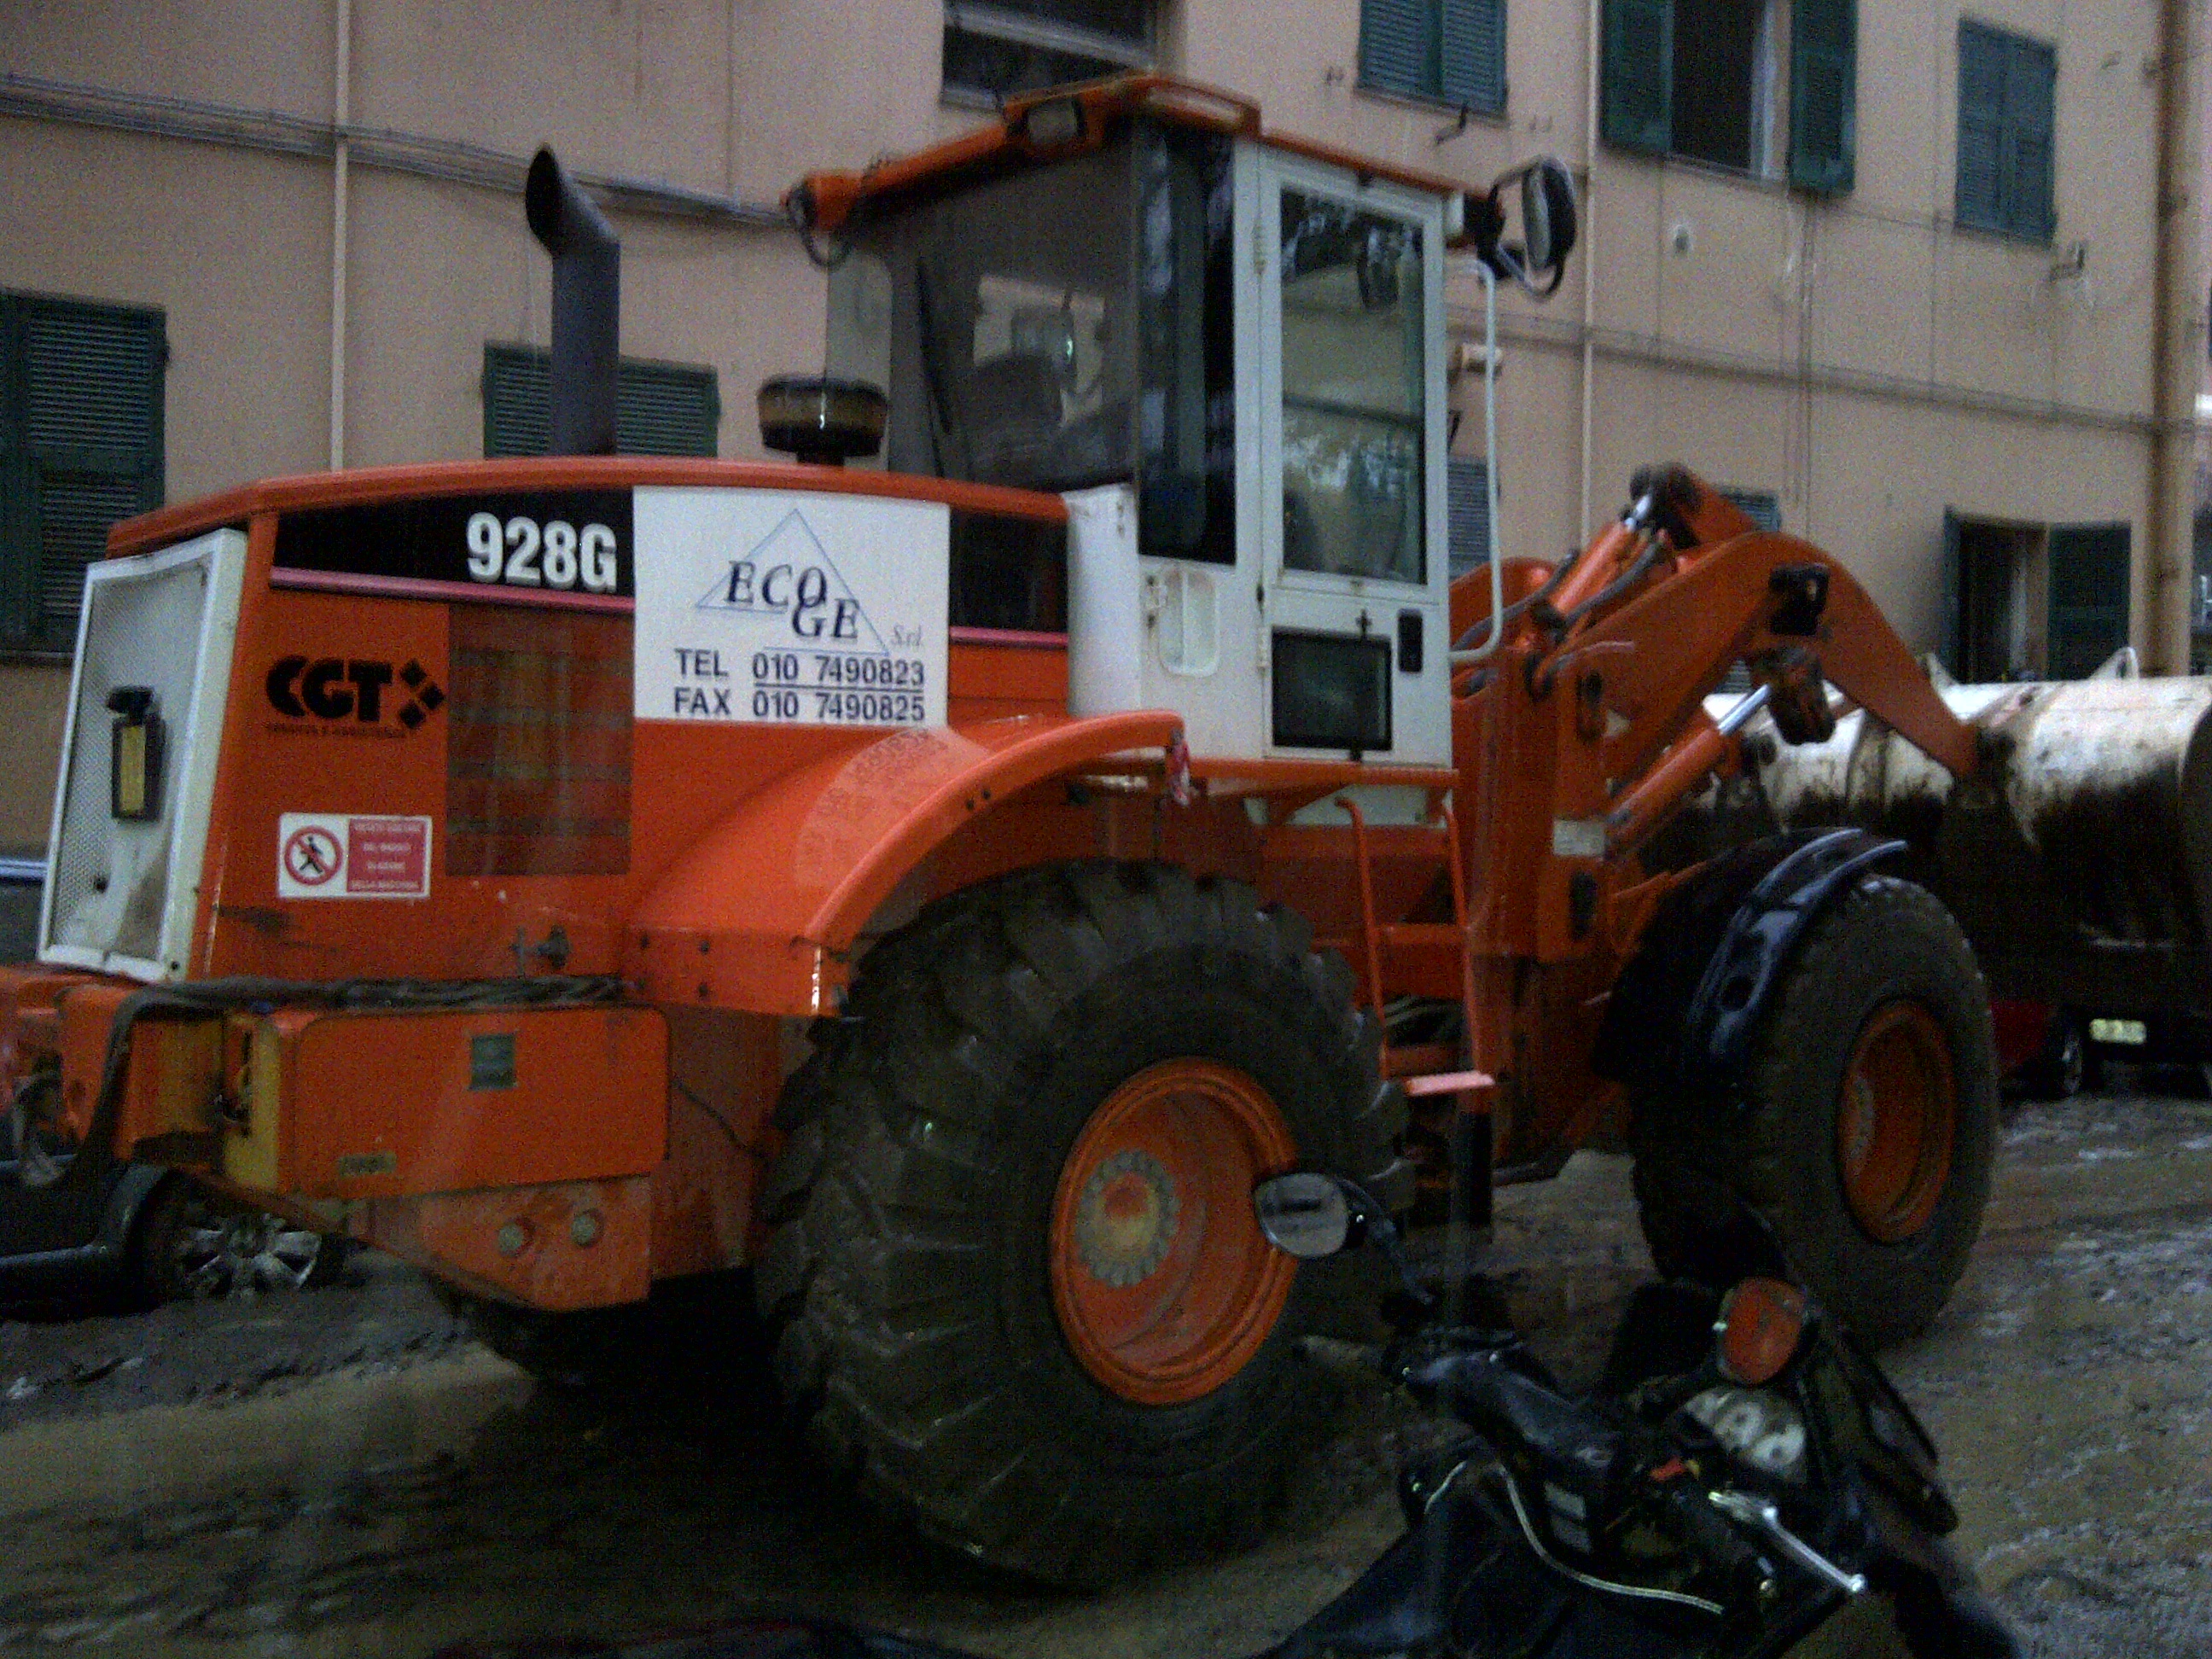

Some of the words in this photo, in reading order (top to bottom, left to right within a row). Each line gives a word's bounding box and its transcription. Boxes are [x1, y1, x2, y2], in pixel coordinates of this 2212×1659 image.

[466, 512, 617, 592] 928G
[725, 560, 827, 608] ECO
[792, 597, 859, 640] GE
[265, 655, 393, 722] CGT
[673, 648, 729, 677] TEL
[753, 652, 799, 680] 010
[814, 655, 924, 686] 7490823
[673, 686, 731, 715] FAX
[753, 690, 799, 719] 010
[815, 692, 925, 722] 7490825
